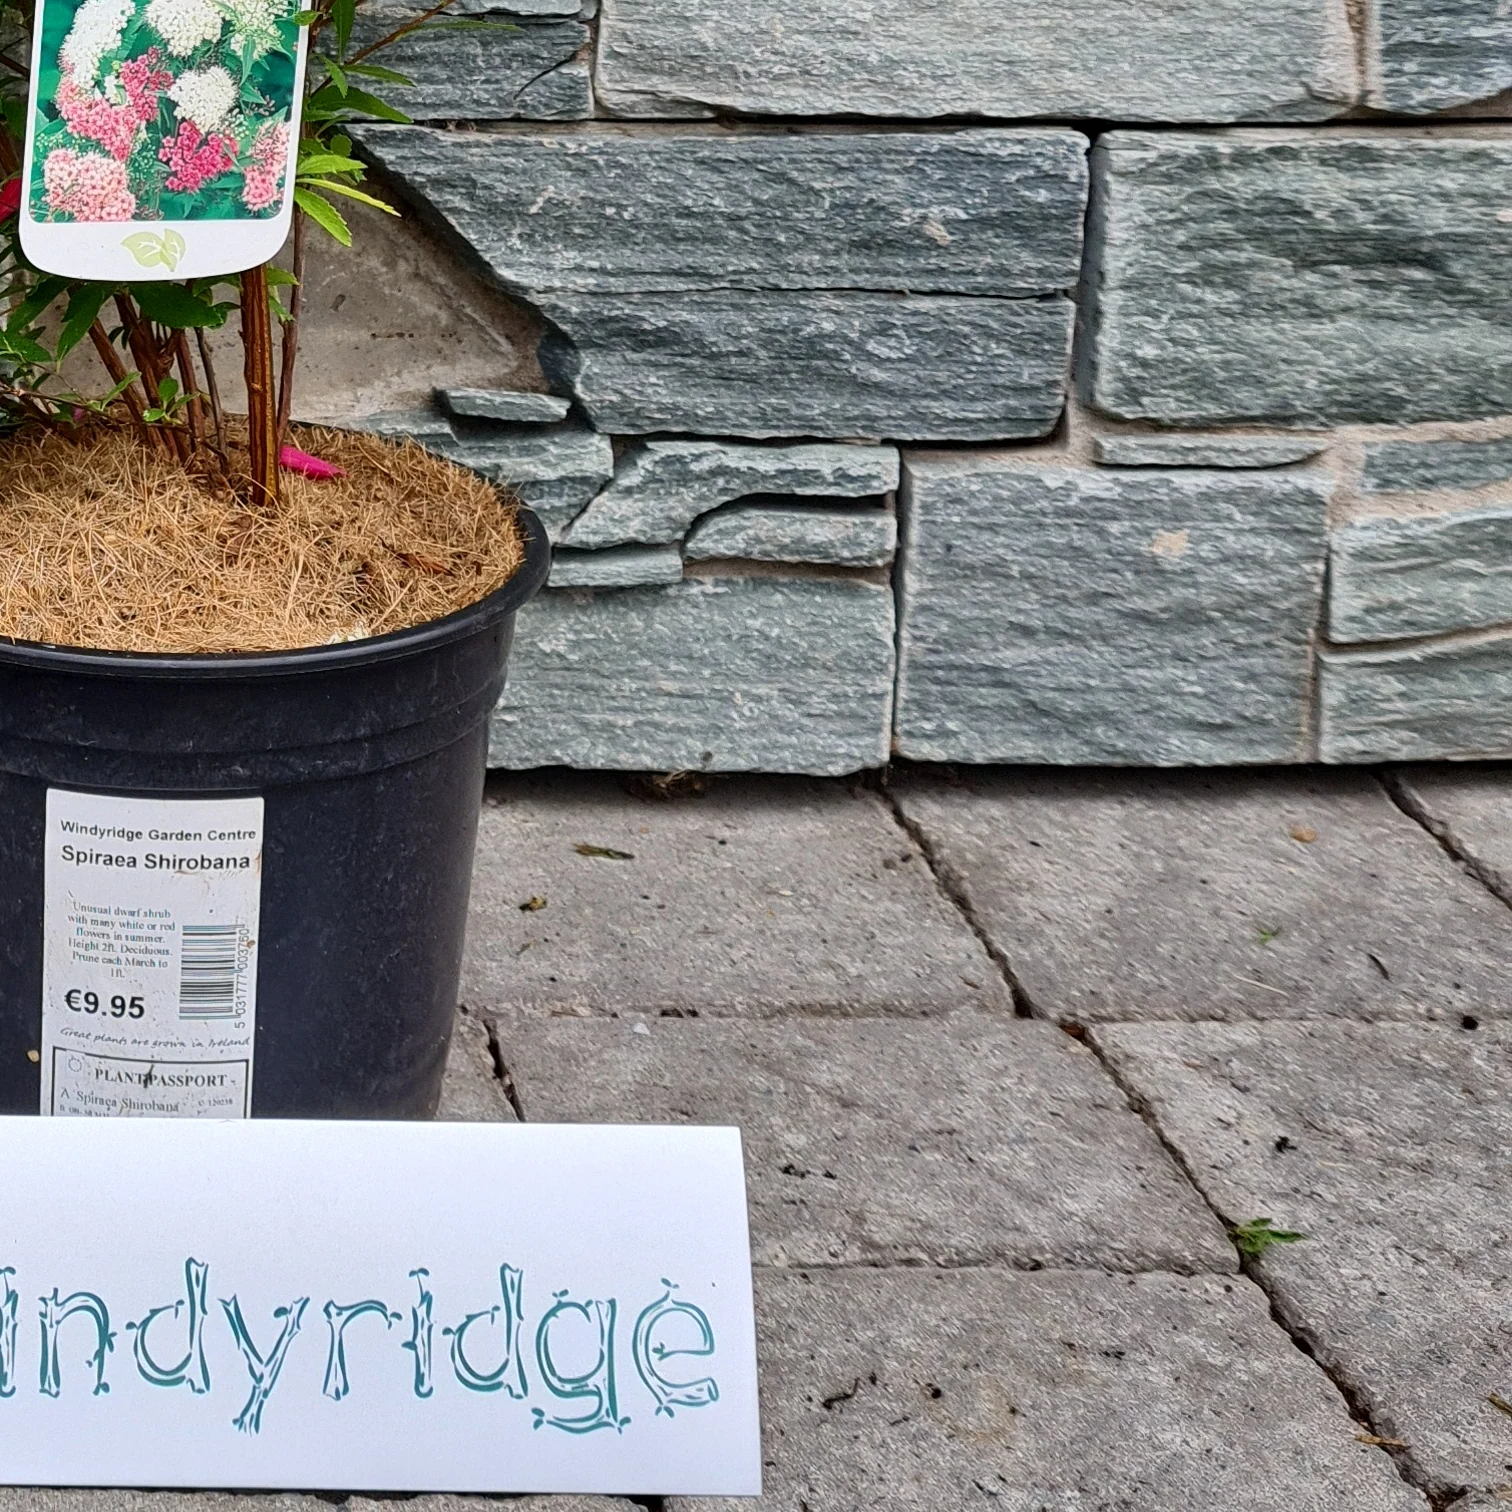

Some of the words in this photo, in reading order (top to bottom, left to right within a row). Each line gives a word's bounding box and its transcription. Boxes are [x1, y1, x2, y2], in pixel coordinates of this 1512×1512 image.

[60, 819, 143, 842] Windyridge
[148, 829, 202, 841] Garden
[207, 829, 257, 841] Centre
[61, 845, 137, 868] Spiraea
[144, 852, 251, 870] Shirobana
[72, 899, 112, 916] Unusual
[113, 906, 141, 918] dwarf
[143, 908, 171, 919] shrub
[68, 914, 88, 925] with
[90, 918, 116, 930] many
[119, 920, 145, 930] white
[146, 923, 158, 931] or
[159, 922, 176, 932] red
[76, 926, 111, 940] flowers
[114, 931, 123, 941] in
[125, 933, 166, 944] summer.
[68, 937, 100, 952] Height
[120, 944, 174, 956] Deciduous.
[72, 950, 100, 964] Prune
[101, 955, 123, 966] each
[124, 957, 156, 968] March
[158, 959, 169, 969] to
[64, 989, 146, 1020] €9.95
[60, 1027, 92, 1040] Great
[94, 1031, 128, 1046] plants
[152, 1040, 188, 1049] grown
[191, 1038, 205, 1048] in
[208, 1037, 251, 1049] Ireland
[94, 1066, 145, 1086] PLANT
[150, 1073, 228, 1088] PASSPORT
